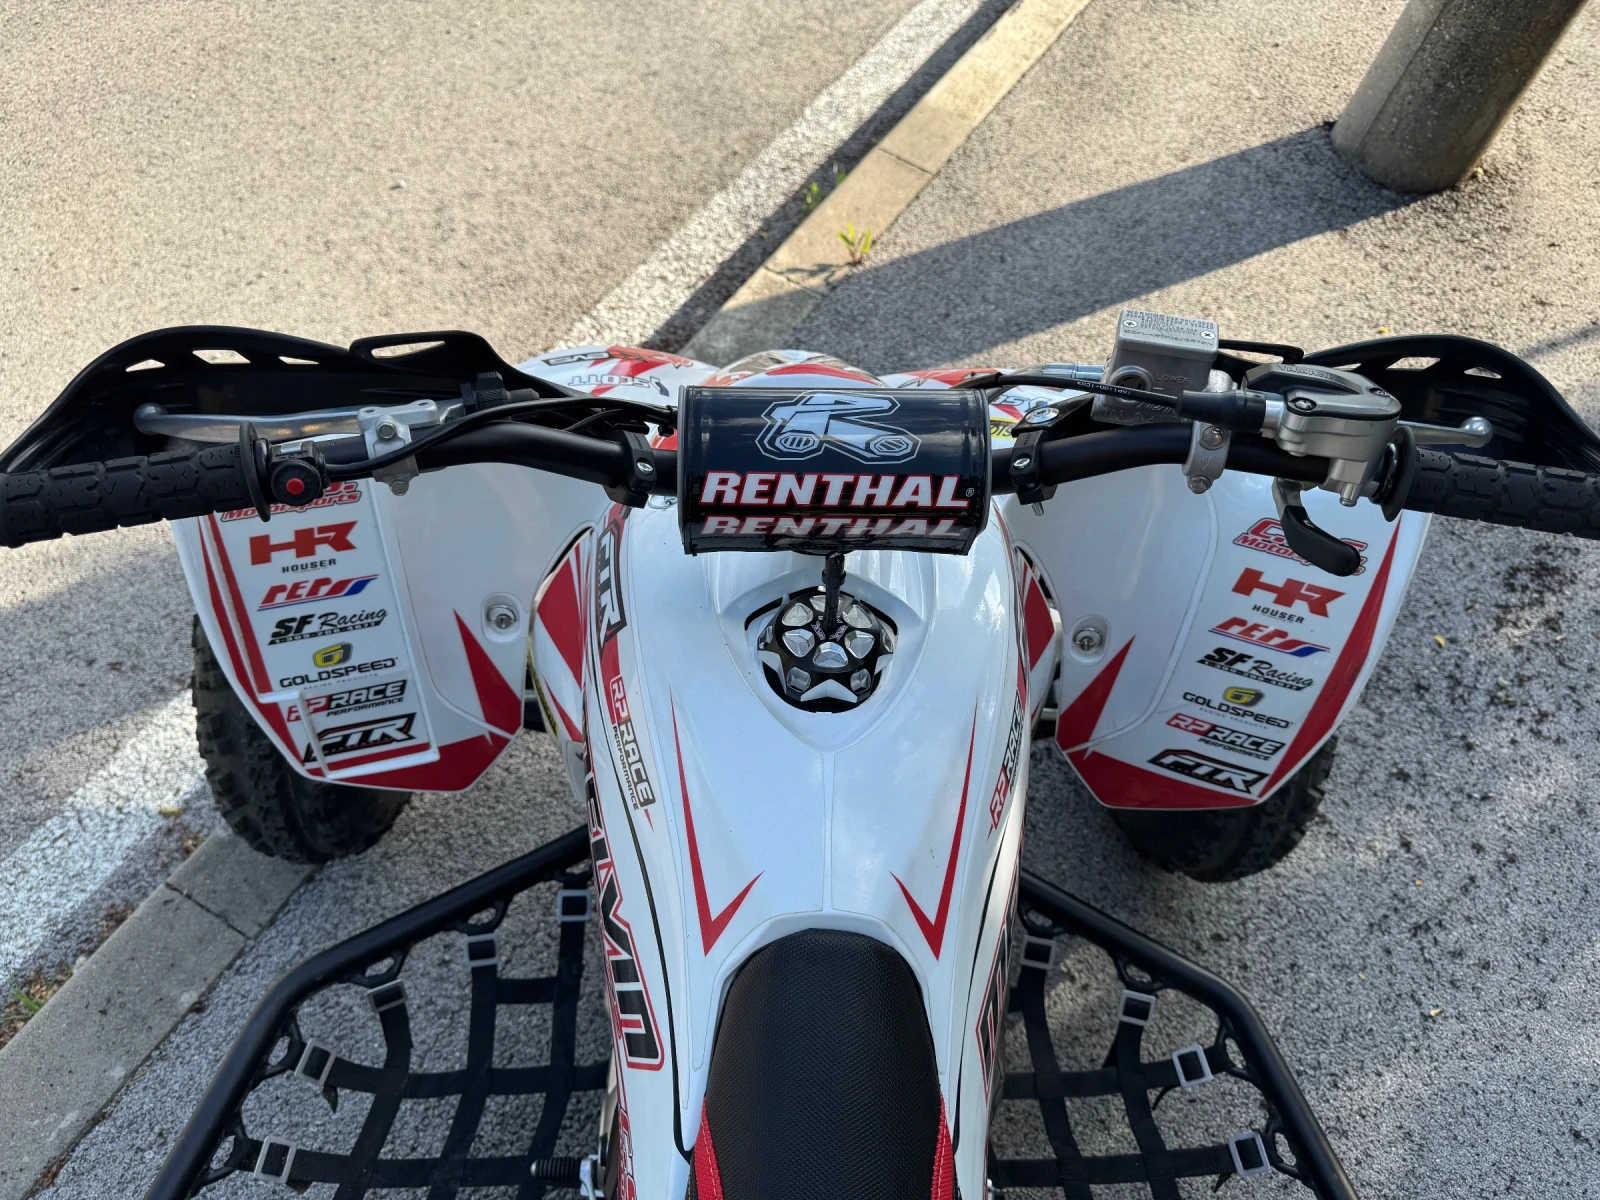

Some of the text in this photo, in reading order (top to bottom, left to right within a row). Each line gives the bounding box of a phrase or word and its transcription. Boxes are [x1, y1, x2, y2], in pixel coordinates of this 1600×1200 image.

[700, 472, 969, 508] RENTHAL
[700, 516, 962, 537] RENTHAL
[249, 521, 358, 565] HR
[282, 559, 337, 573] HOUSER
[1231, 567, 1346, 618] HR
[271, 608, 388, 638] SF Racing
[1252, 604, 1305, 624] HOUSER
[280, 658, 397, 688] GOLDSPEED
[1204, 647, 1314, 687] SF Racing
[327, 697, 404, 717] PERFORMANCE
[330, 682, 405, 708] RACE
[1182, 691, 1290, 729] GOLDSPEED
[1198, 737, 1271, 761] PERFORMANCE
[1205, 726, 1283, 755] RACE
[612, 725, 639, 810] PERFORMANCE
[619, 724, 654, 805] RACE
